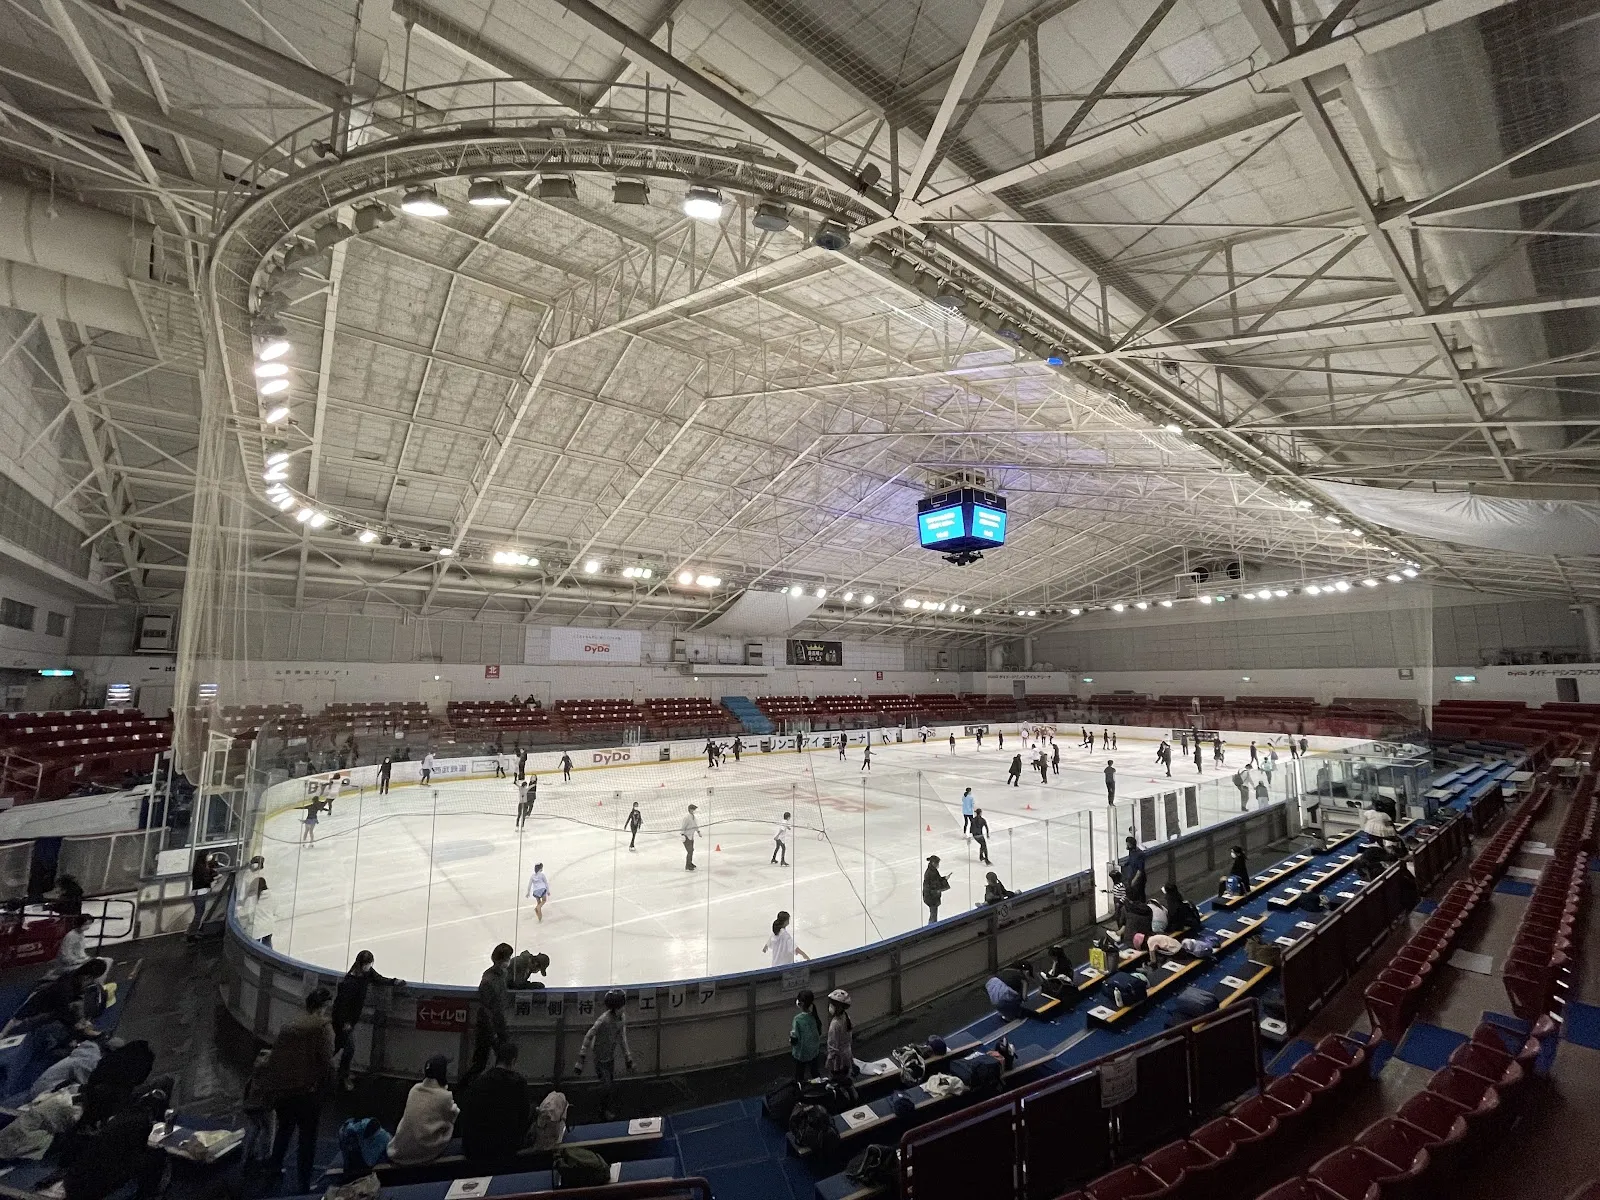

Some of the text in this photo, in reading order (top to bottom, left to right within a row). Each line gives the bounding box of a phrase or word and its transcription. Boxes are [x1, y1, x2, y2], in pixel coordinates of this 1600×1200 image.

[584, 645, 610, 654] DyDo
[593, 752, 631, 765] DyDo
[433, 764, 467, 774] 西武鉄道
[515, 990, 714, 1016] 南側待エリア
[430, 1008, 455, 1020] トイレ
